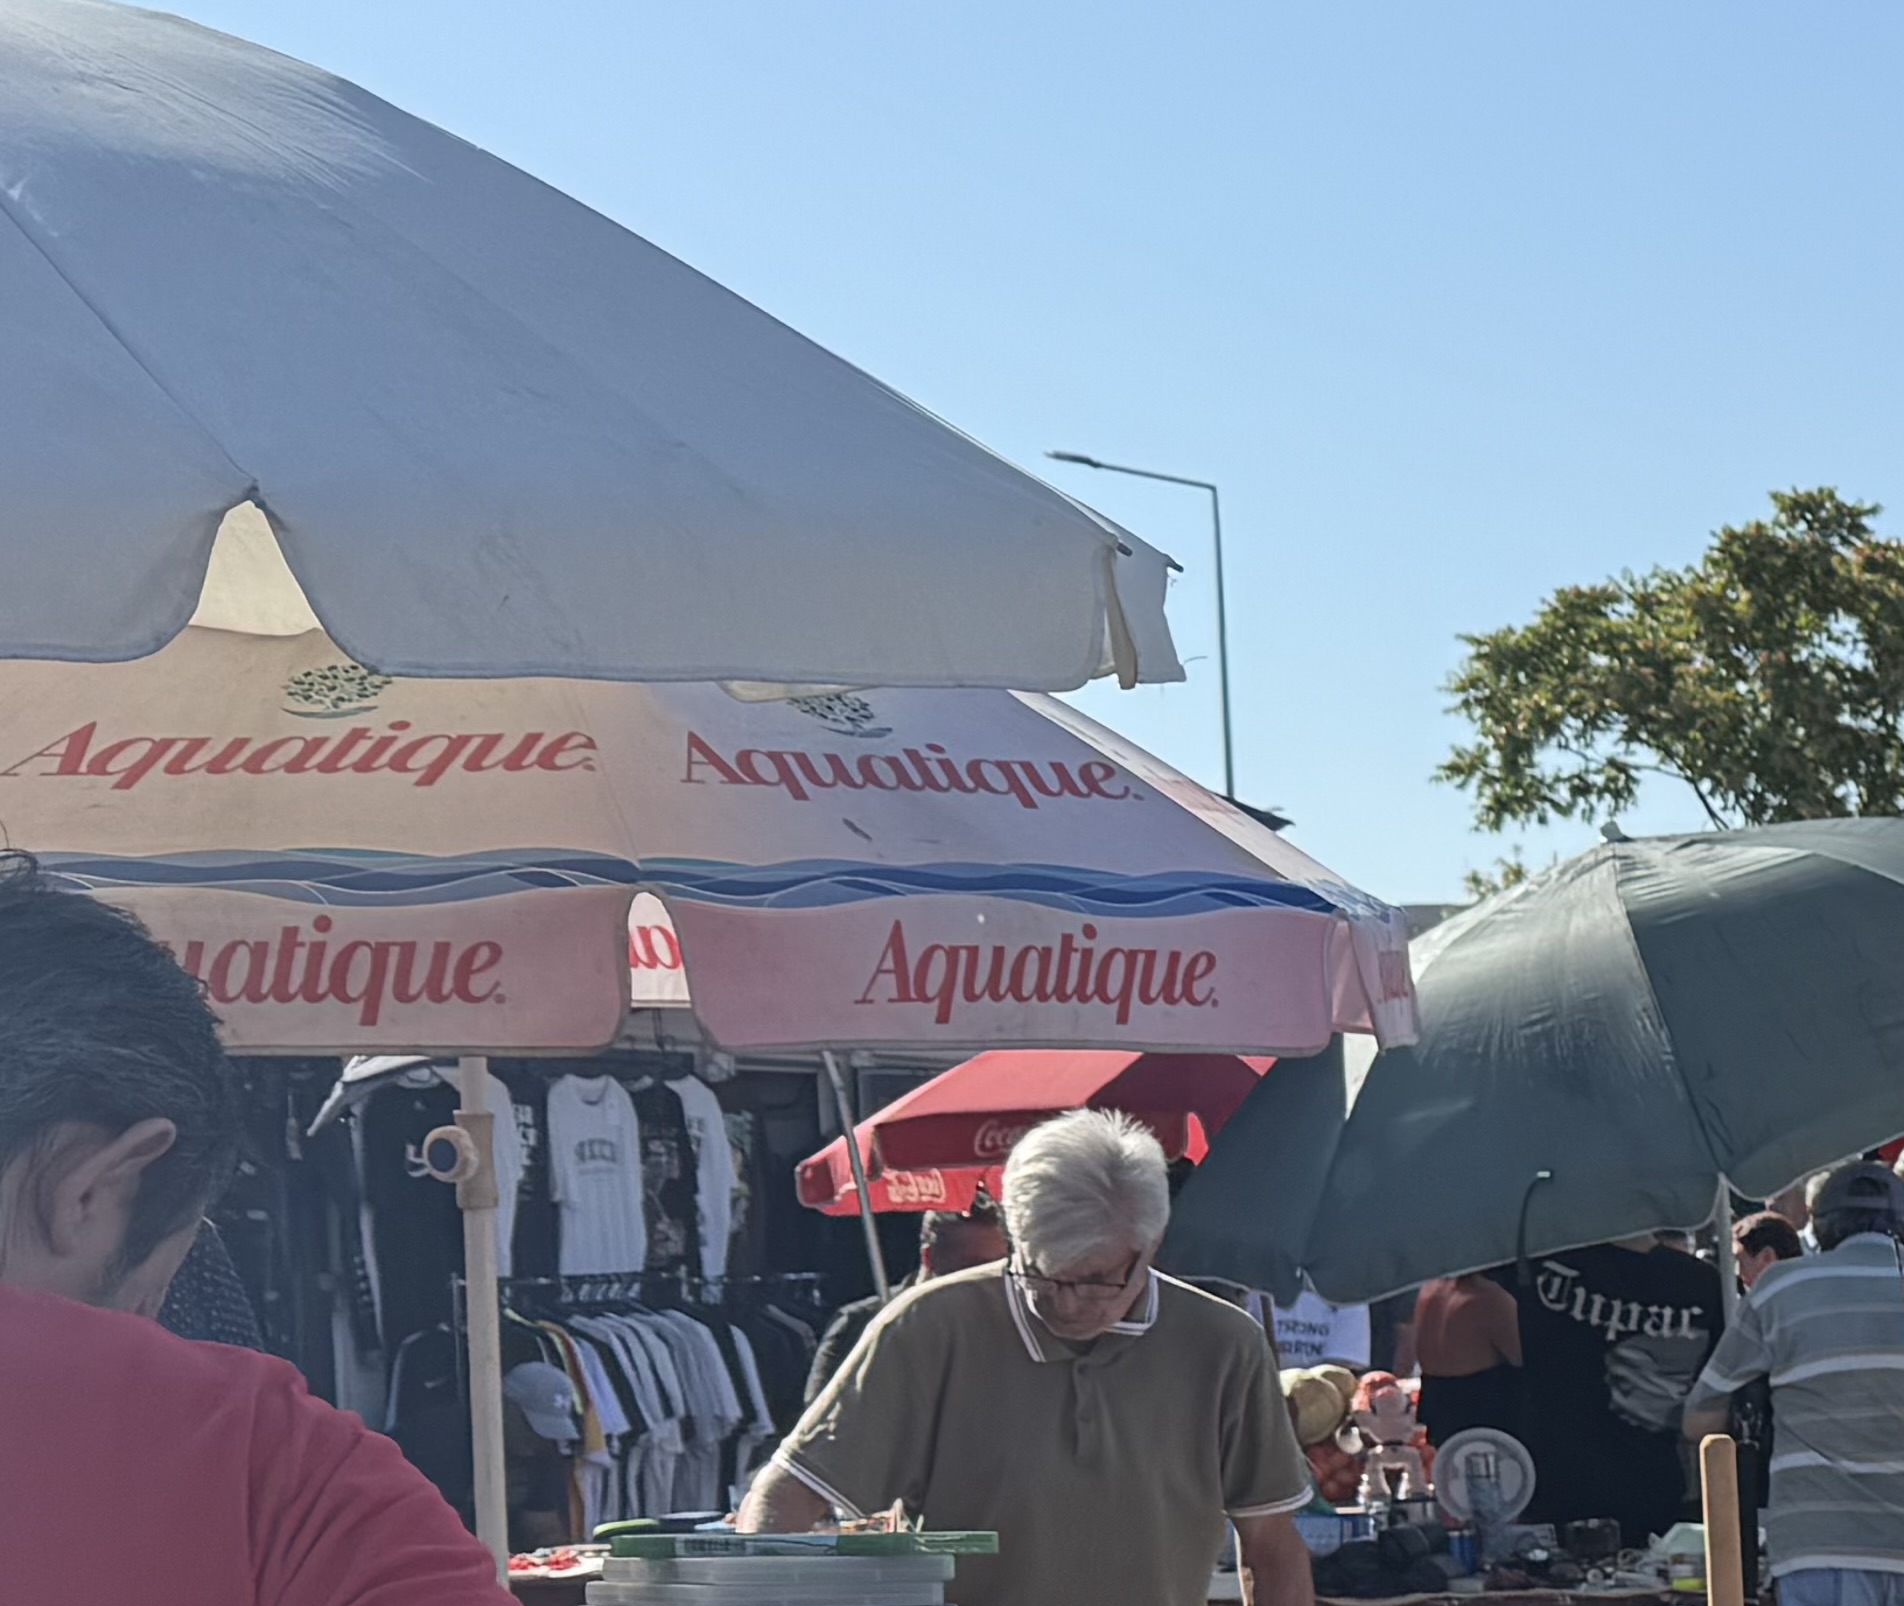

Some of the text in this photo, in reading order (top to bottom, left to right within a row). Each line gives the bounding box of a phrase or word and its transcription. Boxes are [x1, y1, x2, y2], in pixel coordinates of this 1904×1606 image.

[2, 720, 595, 790] Aquatique
[680, 731, 1134, 809] Aquatique
[855, 919, 1219, 1026] Aquatique
